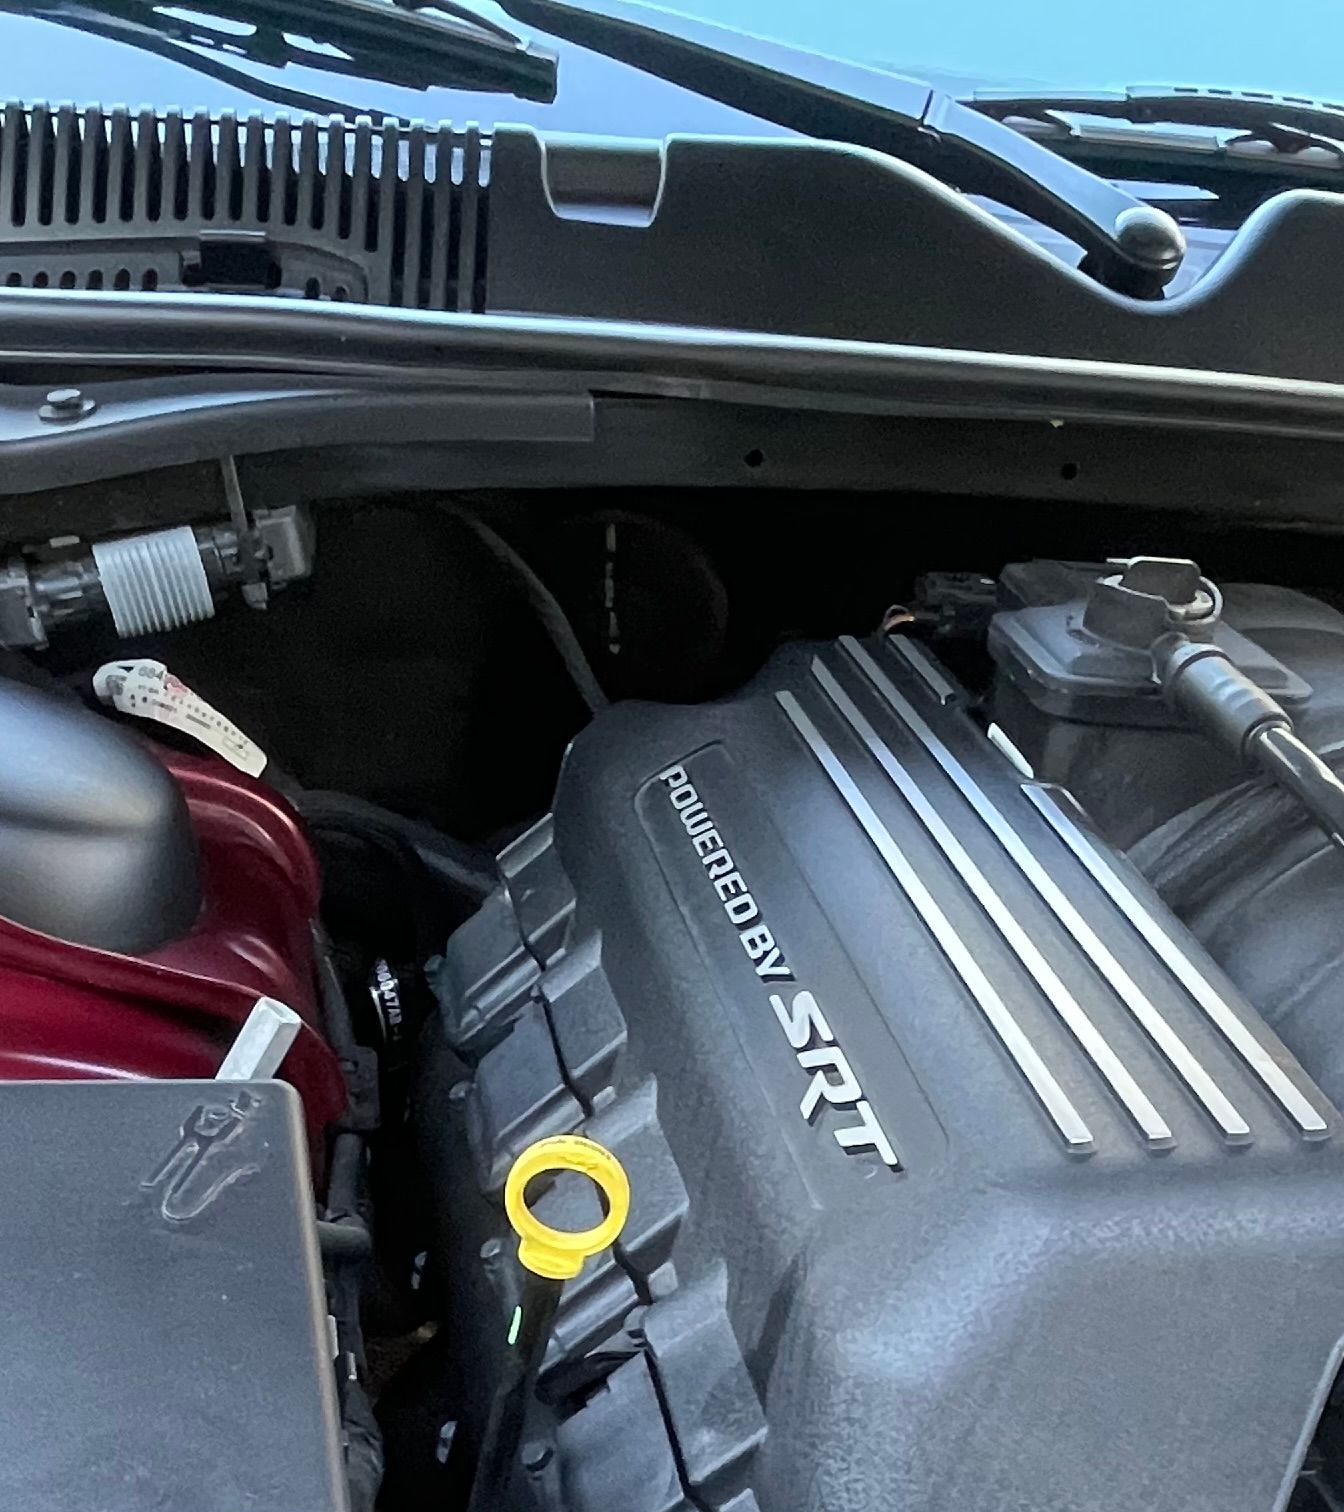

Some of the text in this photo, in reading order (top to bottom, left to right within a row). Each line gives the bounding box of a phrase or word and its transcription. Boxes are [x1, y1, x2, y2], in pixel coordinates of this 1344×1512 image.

[658, 764, 898, 1166] POWERED BY SRT
